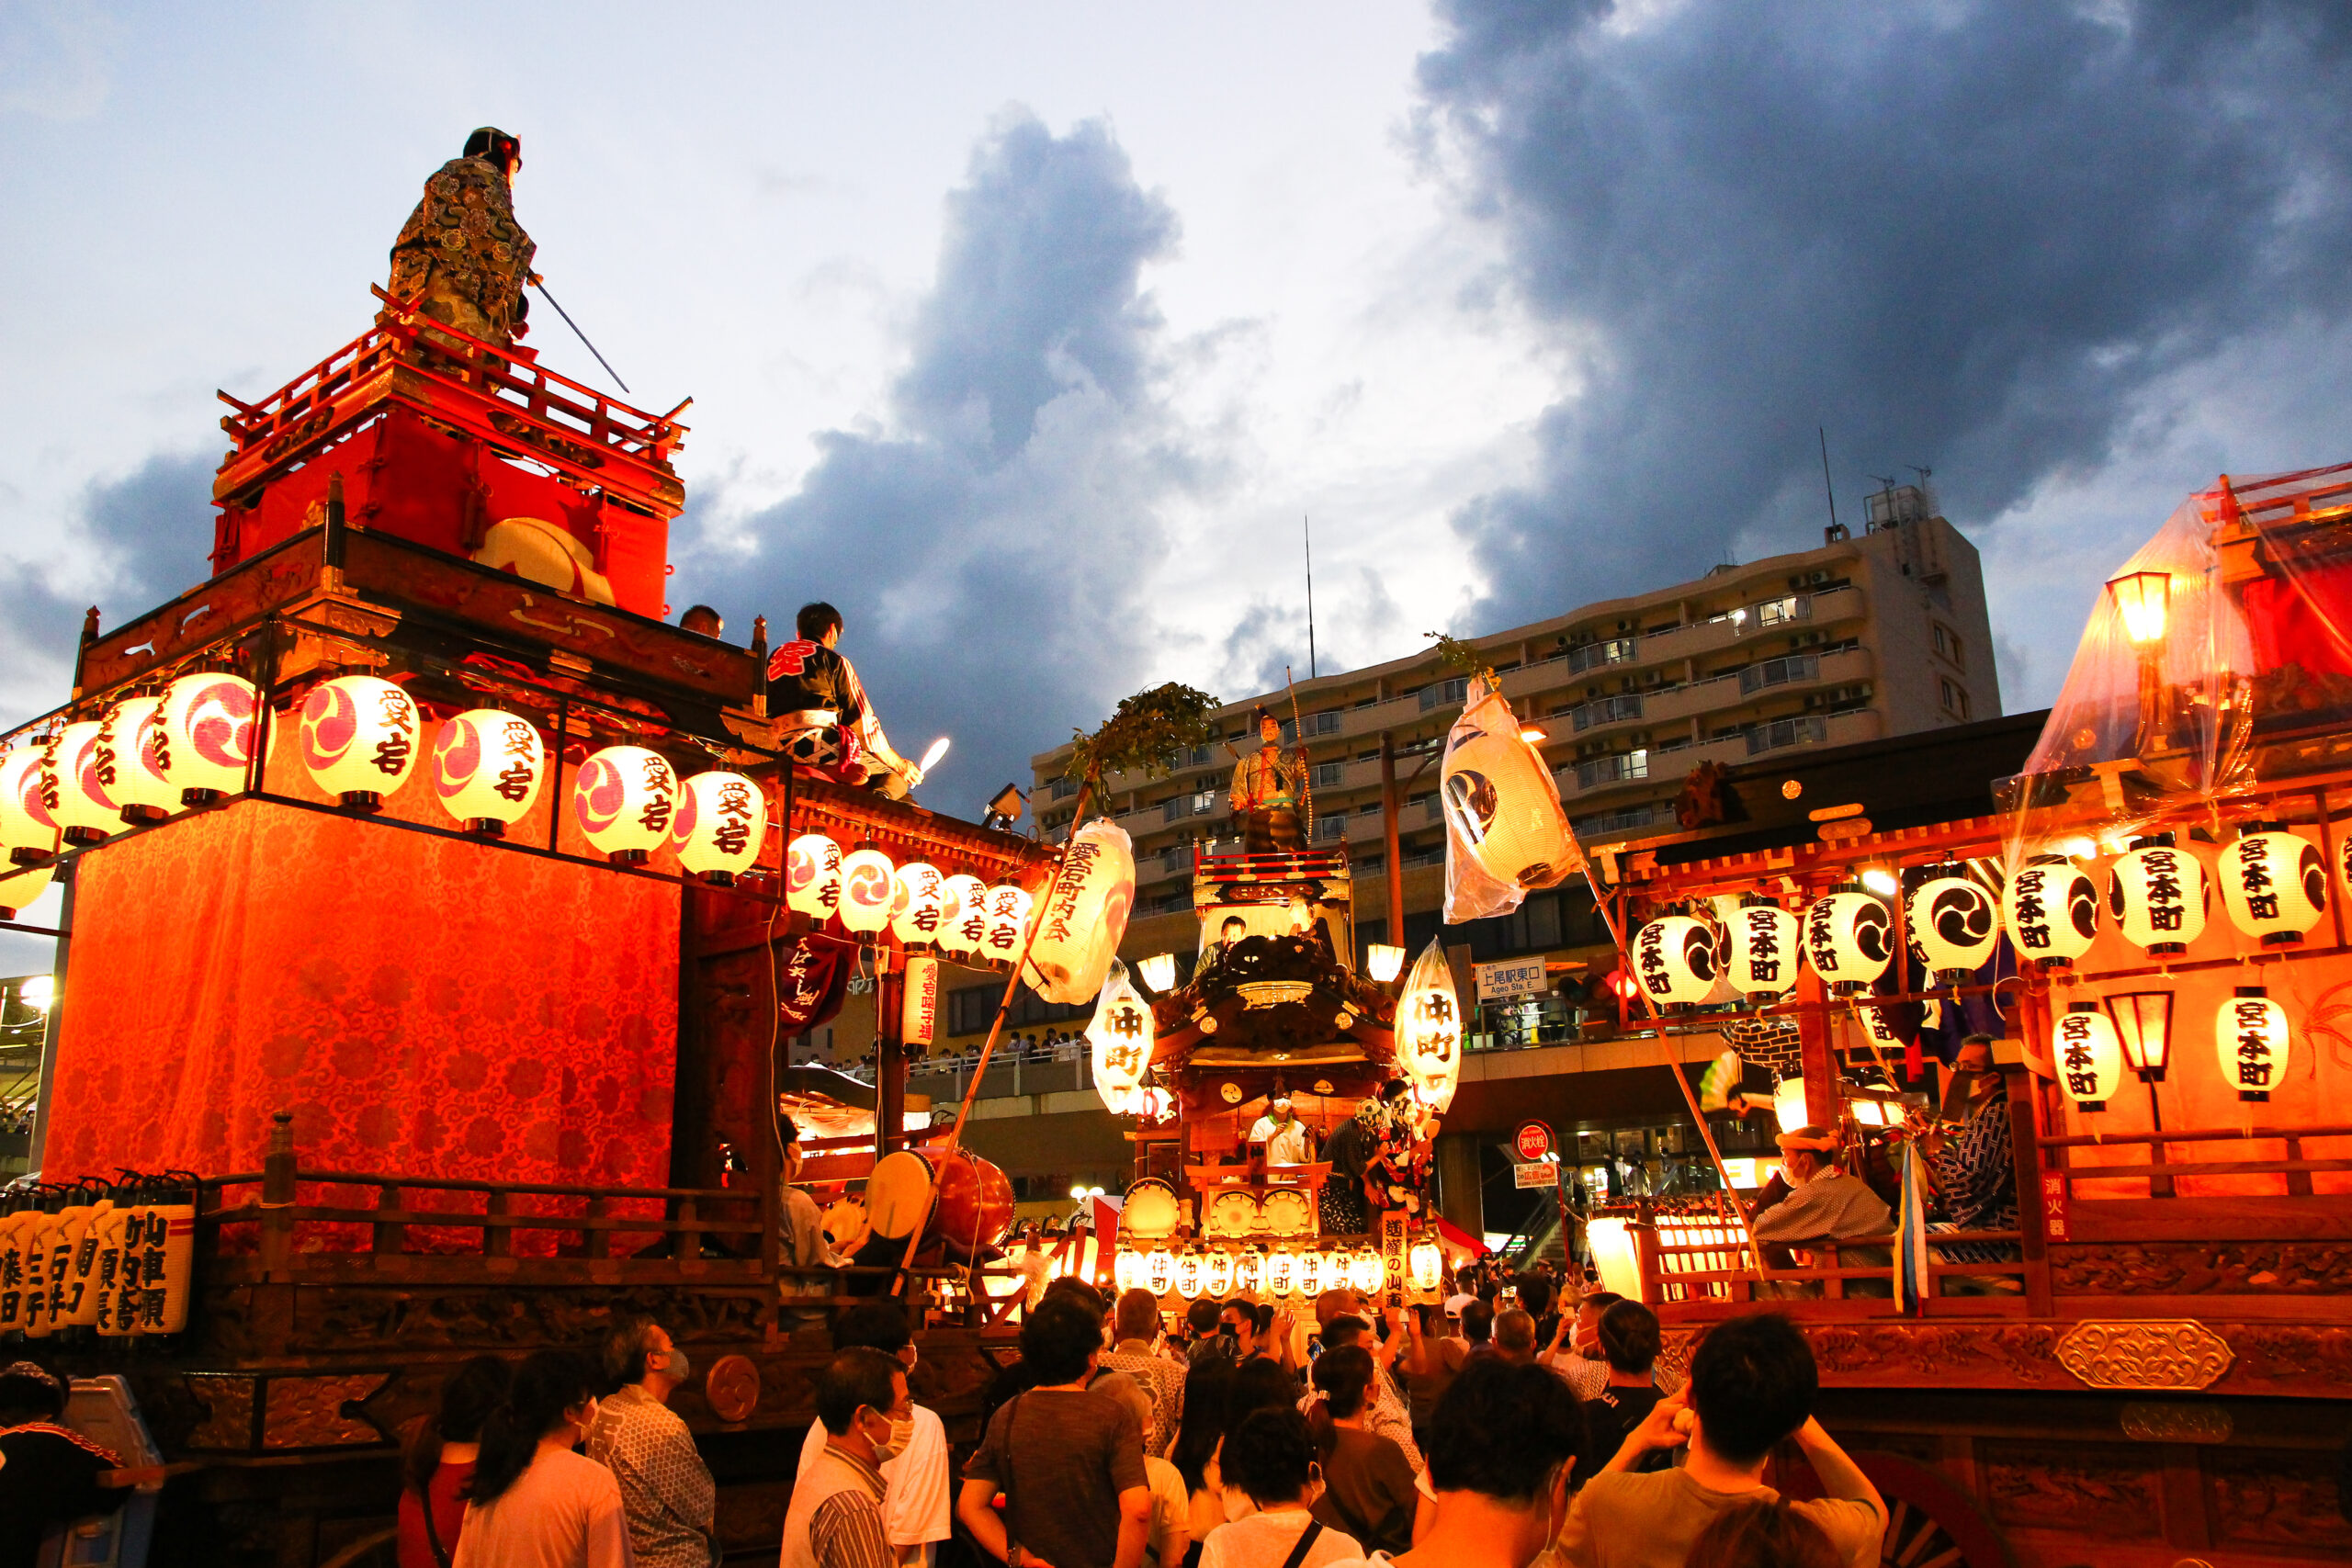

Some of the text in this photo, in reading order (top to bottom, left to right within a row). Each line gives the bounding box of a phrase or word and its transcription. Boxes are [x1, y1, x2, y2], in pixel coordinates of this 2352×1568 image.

[370, 690, 413, 775] 愛宕
[493, 721, 536, 803] 愛宕
[639, 756, 673, 833] 愛宕
[712, 782, 752, 855] 愛宕
[817, 843, 842, 908] 愛宕
[911, 870, 941, 931] 愛宕
[1044, 842, 1102, 942] 愛宕町内会
[2015, 871, 2051, 949] 宮本町
[2141, 852, 2185, 931] 宮本町
[2239, 839, 2279, 919] 宮本町
[960, 883, 987, 942] 愛宕
[989, 891, 1018, 949] 愛宕
[1747, 909, 1781, 982] 宮本町
[1809, 897, 1839, 971] 宮本町
[1483, 966, 1540, 987] 上尾駅東口
[1492, 986, 1509, 994] Ageo
[1511, 983, 1524, 991] Sta.
[1640, 923, 1672, 996] 宮本町
[2063, 1016, 2098, 1095] 宮本町
[2235, 1002, 2273, 1087] 宮本町
[1521, 1135, 1545, 1150] 消火栓
[2045, 1178, 2065, 1235] 消火器
[1152, 1258, 1167, 1290] 仲町
[1181, 1261, 1197, 1292] 仲町
[1212, 1259, 1227, 1291] 仲町
[1274, 1259, 1291, 1290] 仲町
[1304, 1258, 1317, 1292] 仲町
[1385, 1219, 1403, 1308] 道灌の山車
